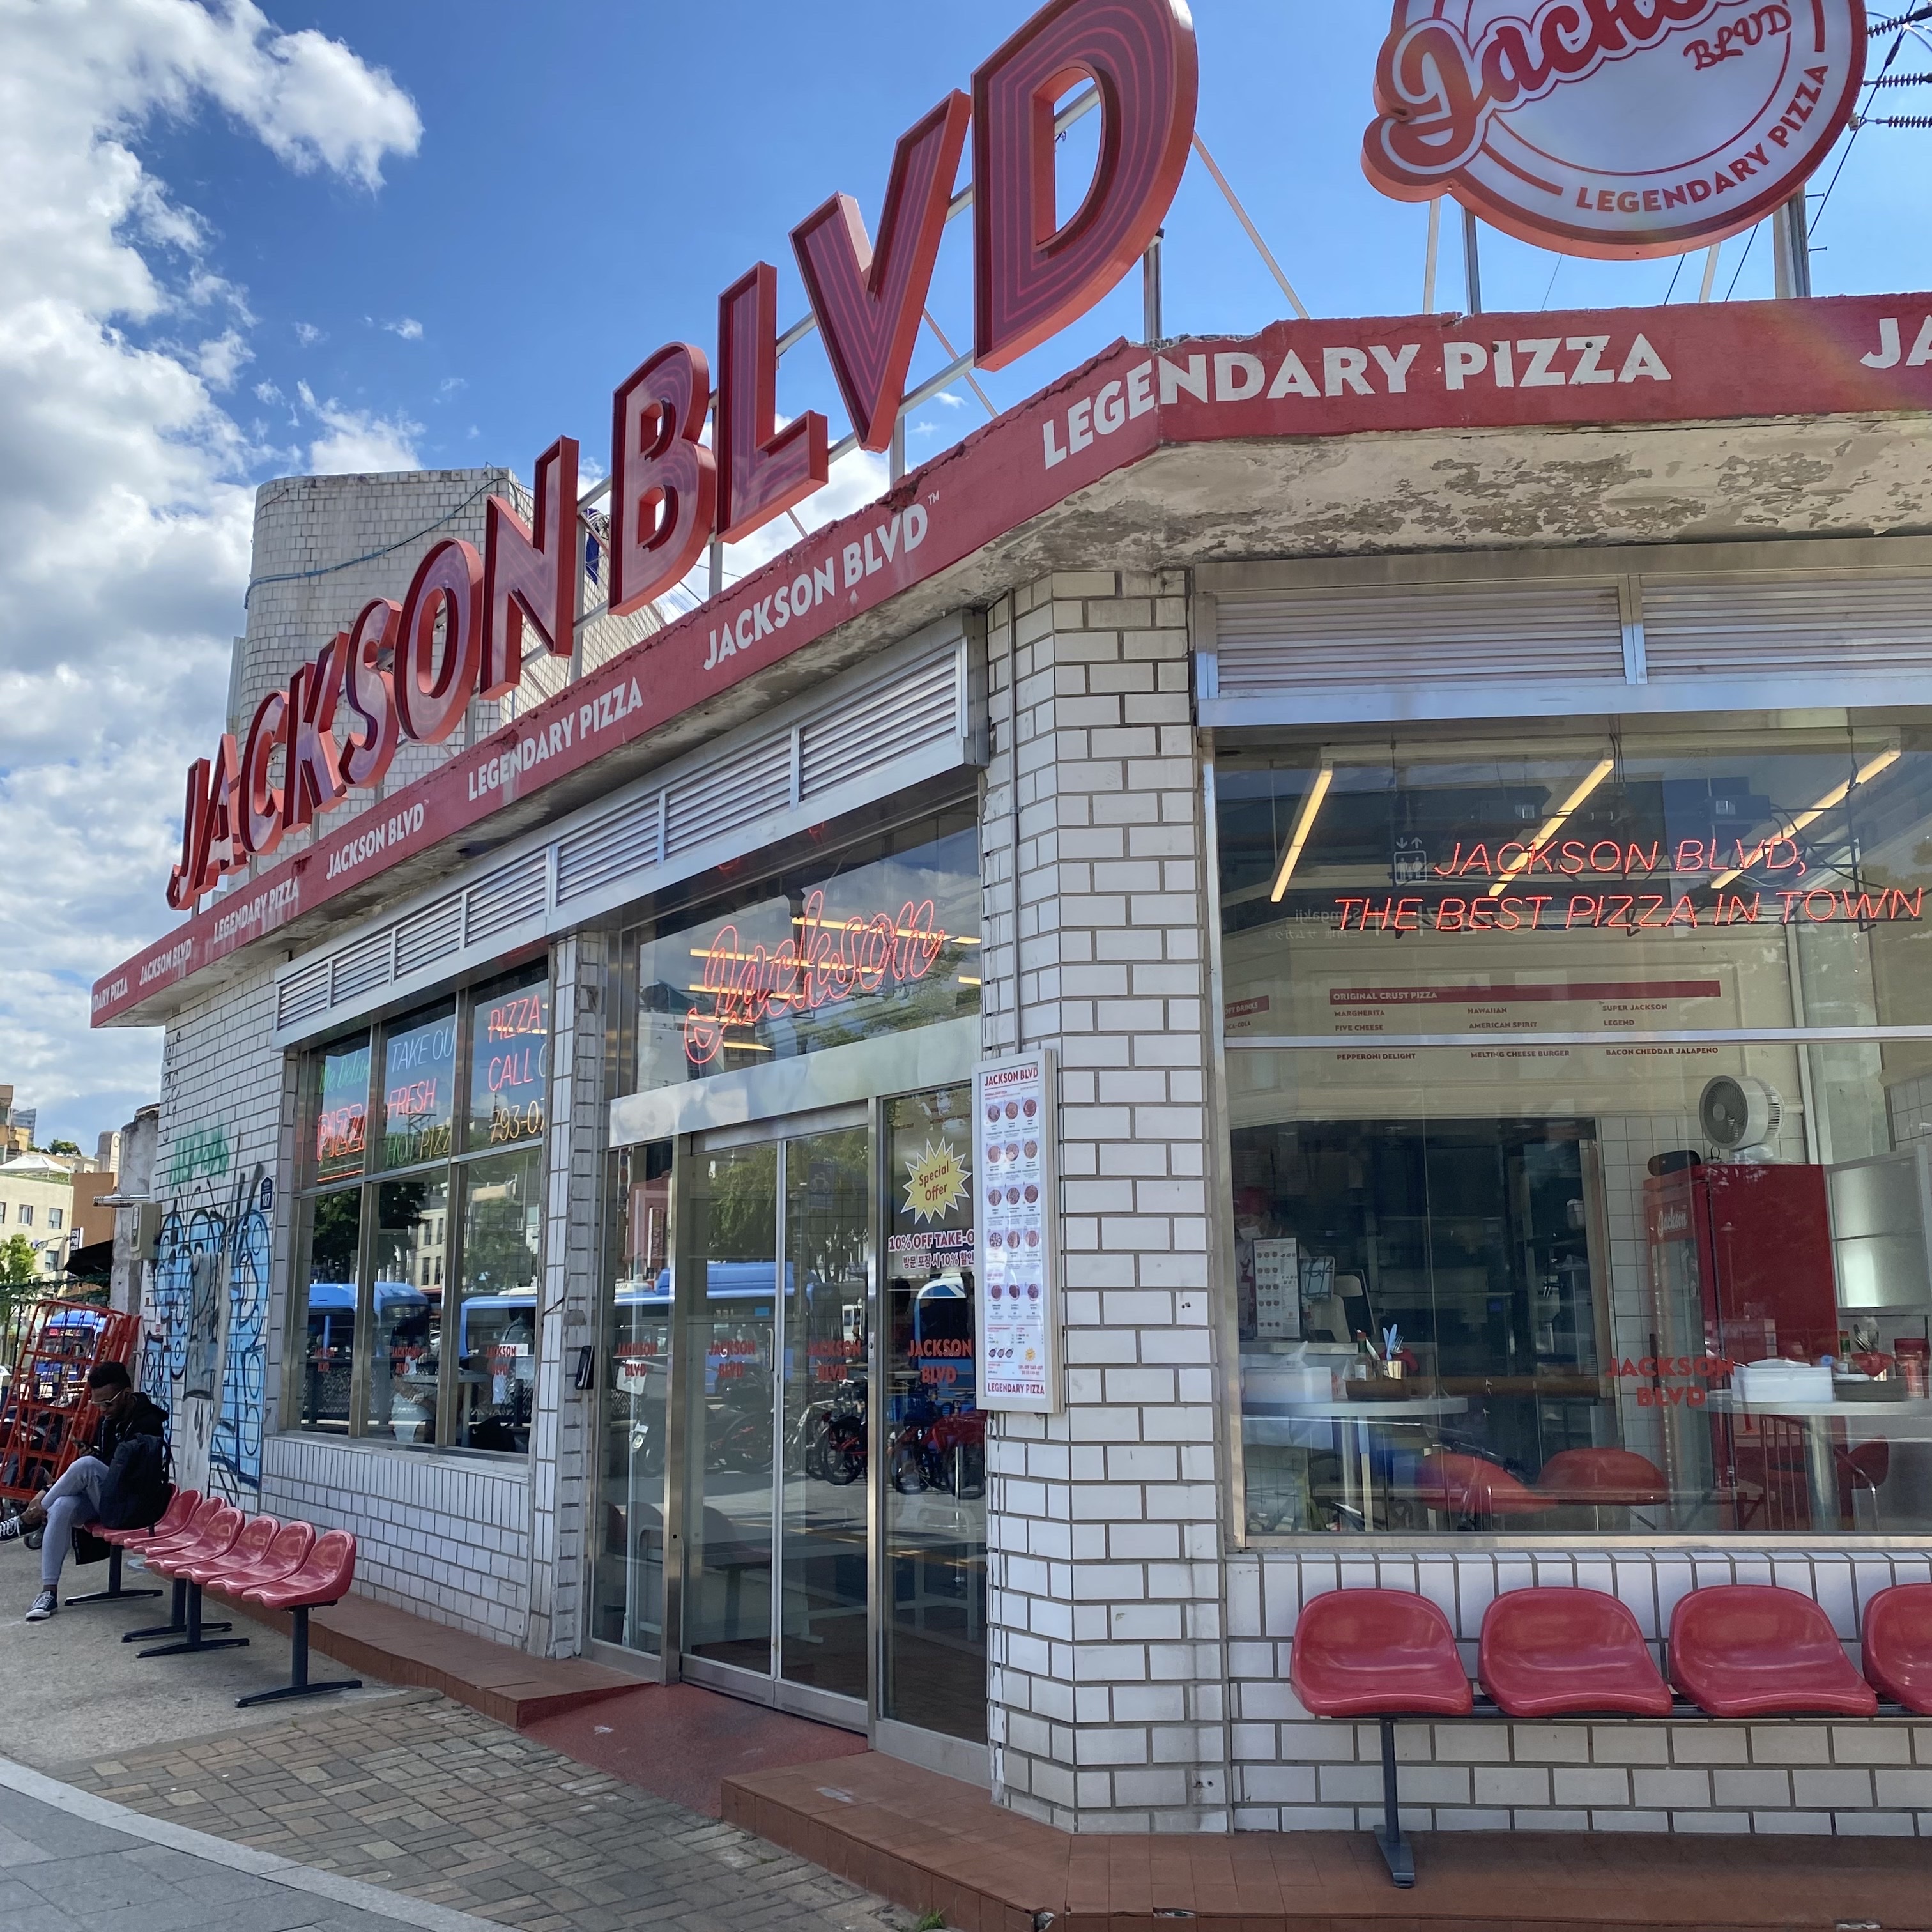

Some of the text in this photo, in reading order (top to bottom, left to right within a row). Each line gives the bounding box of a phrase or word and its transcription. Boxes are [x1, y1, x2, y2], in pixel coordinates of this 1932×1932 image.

[1683, 4, 1791, 70] BLVD
[1575, 66, 1828, 213] LEGENDARY PIZZA
[1043, 333, 1672, 470] LEGENDARY PIZZA
[165, 0, 1197, 910] JACKSON BLVD
[703, 556, 835, 671] JACKSON
[468, 675, 644, 802] LEGENDARY PIZZA
[326, 824, 385, 880] JACKSON
[1434, 837, 1807, 877] JACKSON BLVD,
[213, 875, 299, 944] LEGENDARY PIZZA
[1335, 886, 1923, 931] THE BEST PIZZA IN TOWN
[139, 949, 172, 986] JACKSON
[684, 890, 946, 1064] Jackson
[110, 976, 128, 1002] PIZZA
[1333, 991, 1438, 1000] ORIGINAL CRUST PIZZA
[489, 994, 540, 1043] PIZZA
[1236, 1002, 1258, 1013] DRINKS
[391, 1034, 430, 1073] TAKE
[488, 1047, 533, 1091] CALL
[985, 1067, 1038, 1086] JACKSON BLVD
[387, 1077, 437, 1120] FRESH
[385, 1131, 418, 1167] HOT
[919, 1160, 949, 1188] Special
[262, 1193, 271, 1207] 187
[925, 1183, 947, 1202] Offer
[1657, 1205, 1689, 1239] Jackson
[888, 1234, 912, 1252] 10%
[913, 1232, 933, 1249] OFF
[903, 1254, 917, 1269] 방문
[941, 1251, 959, 1266] 10%
[908, 1338, 972, 1357] JACKSON
[922, 1365, 957, 1383] BLVD
[1604, 1356, 1735, 1377] JACKSON
[988, 1382, 1045, 1395] LEGENDARY PIZZA
[1636, 1387, 1706, 1406] BLVD
